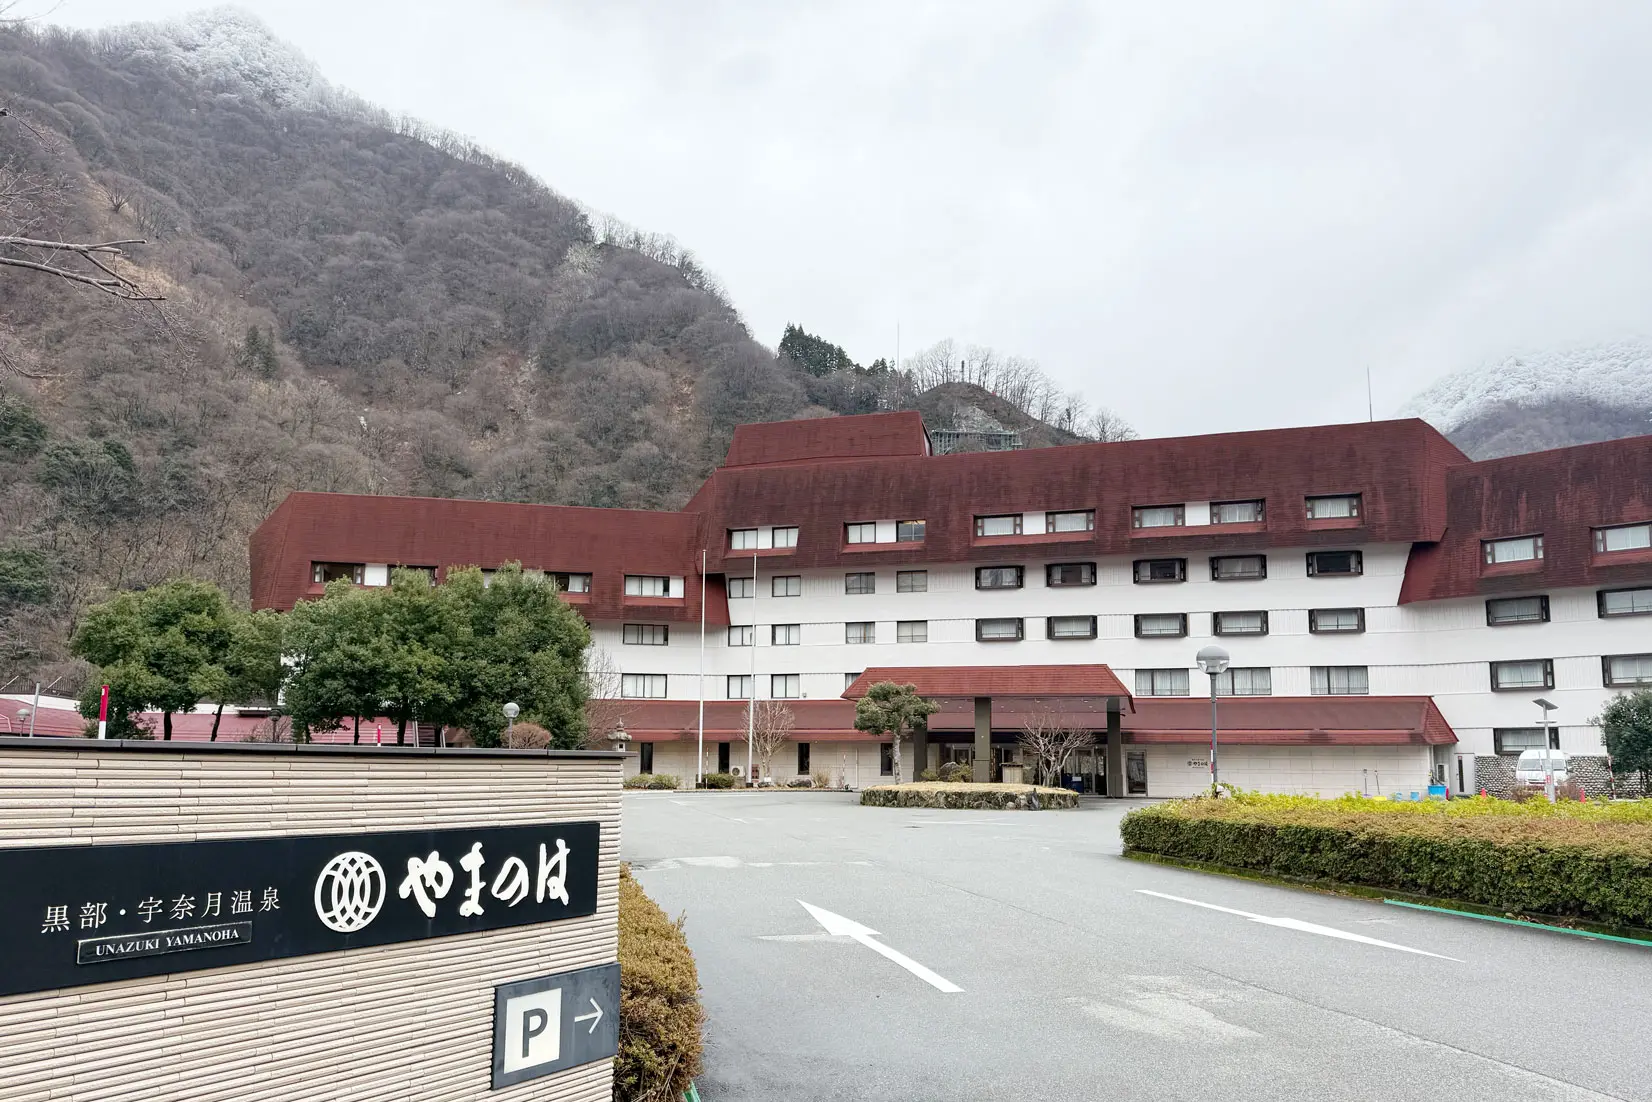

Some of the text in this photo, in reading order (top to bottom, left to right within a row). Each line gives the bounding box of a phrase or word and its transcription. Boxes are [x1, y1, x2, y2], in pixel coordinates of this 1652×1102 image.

[399, 838, 571, 918] やまのは
[41, 886, 281, 934] 黒部・宇奈月温泉
[95, 928, 240, 957] UNAZUKI YAMANOHA
[522, 1007, 548, 1059] P
